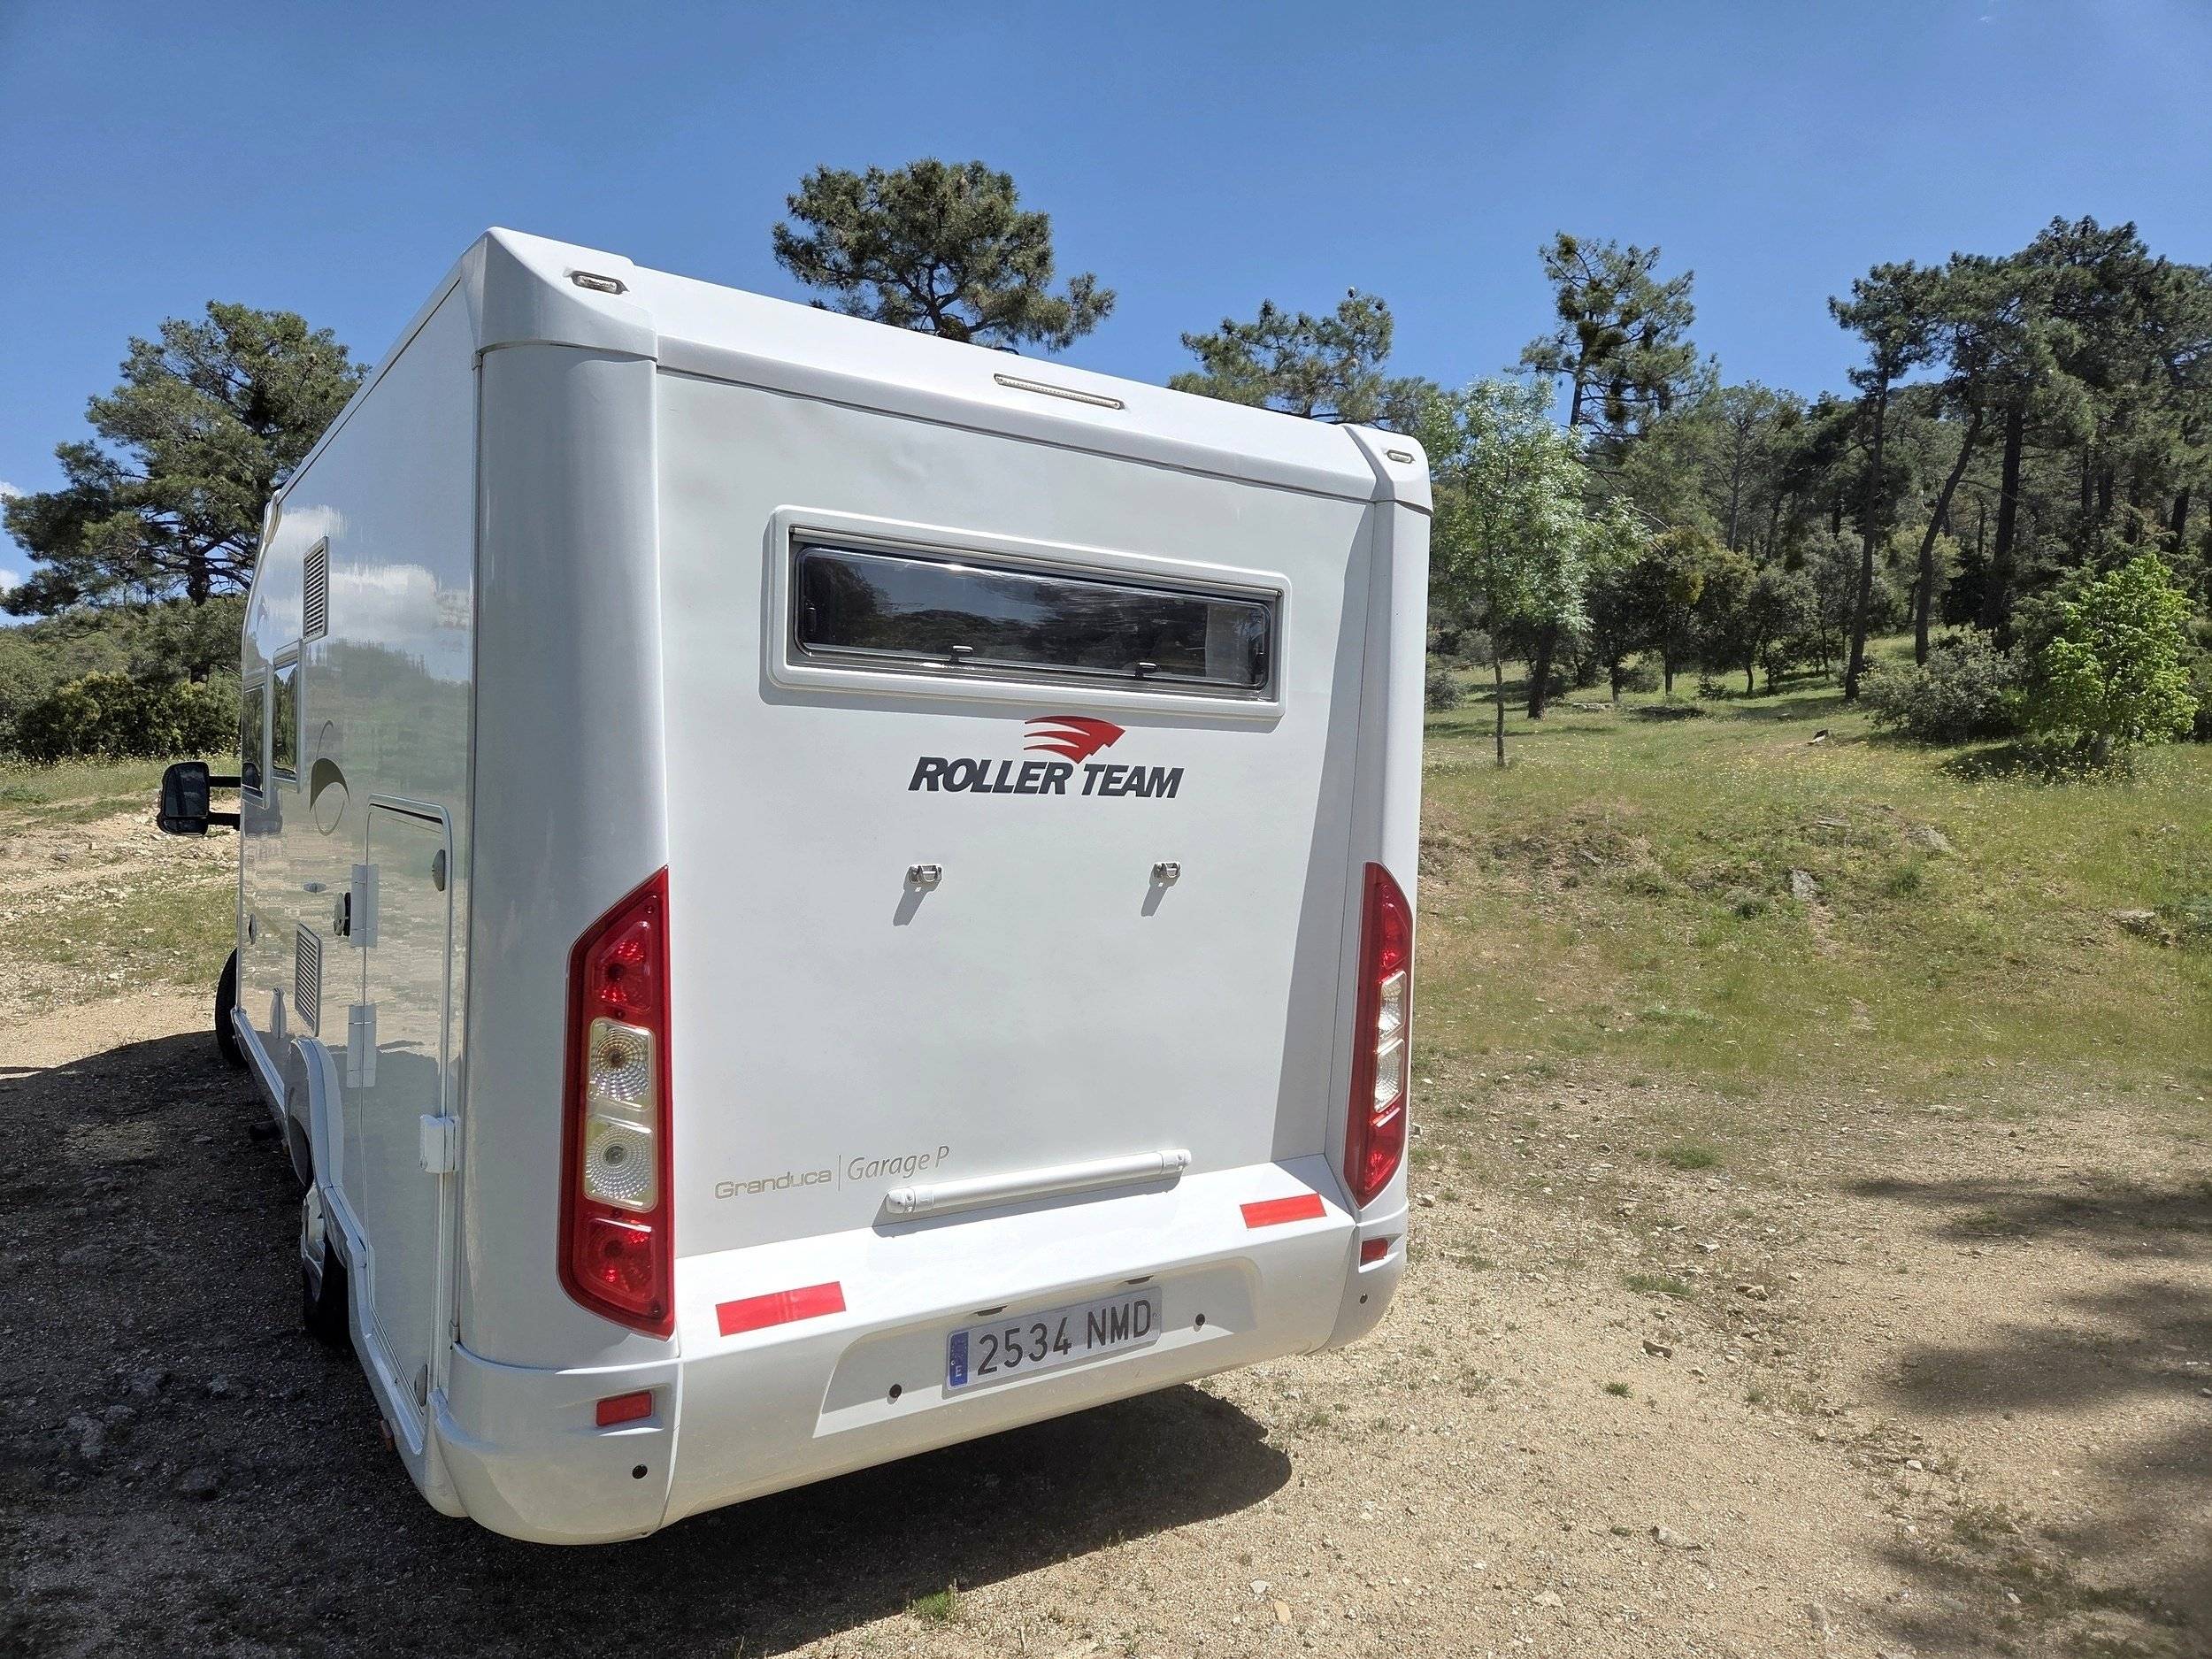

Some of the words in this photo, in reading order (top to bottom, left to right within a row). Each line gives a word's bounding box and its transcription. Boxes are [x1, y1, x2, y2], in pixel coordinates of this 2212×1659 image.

[908, 757, 1073, 795] ROLLER
[1081, 764, 1185, 798] TEAM
[714, 1170, 832, 1200] Granduca
[847, 1153, 931, 1181] Garage
[935, 1145, 950, 1168] P
[955, 1364, 963, 1378] E
[977, 1317, 1072, 1376] 2534
[1087, 1299, 1151, 1349] NMD
